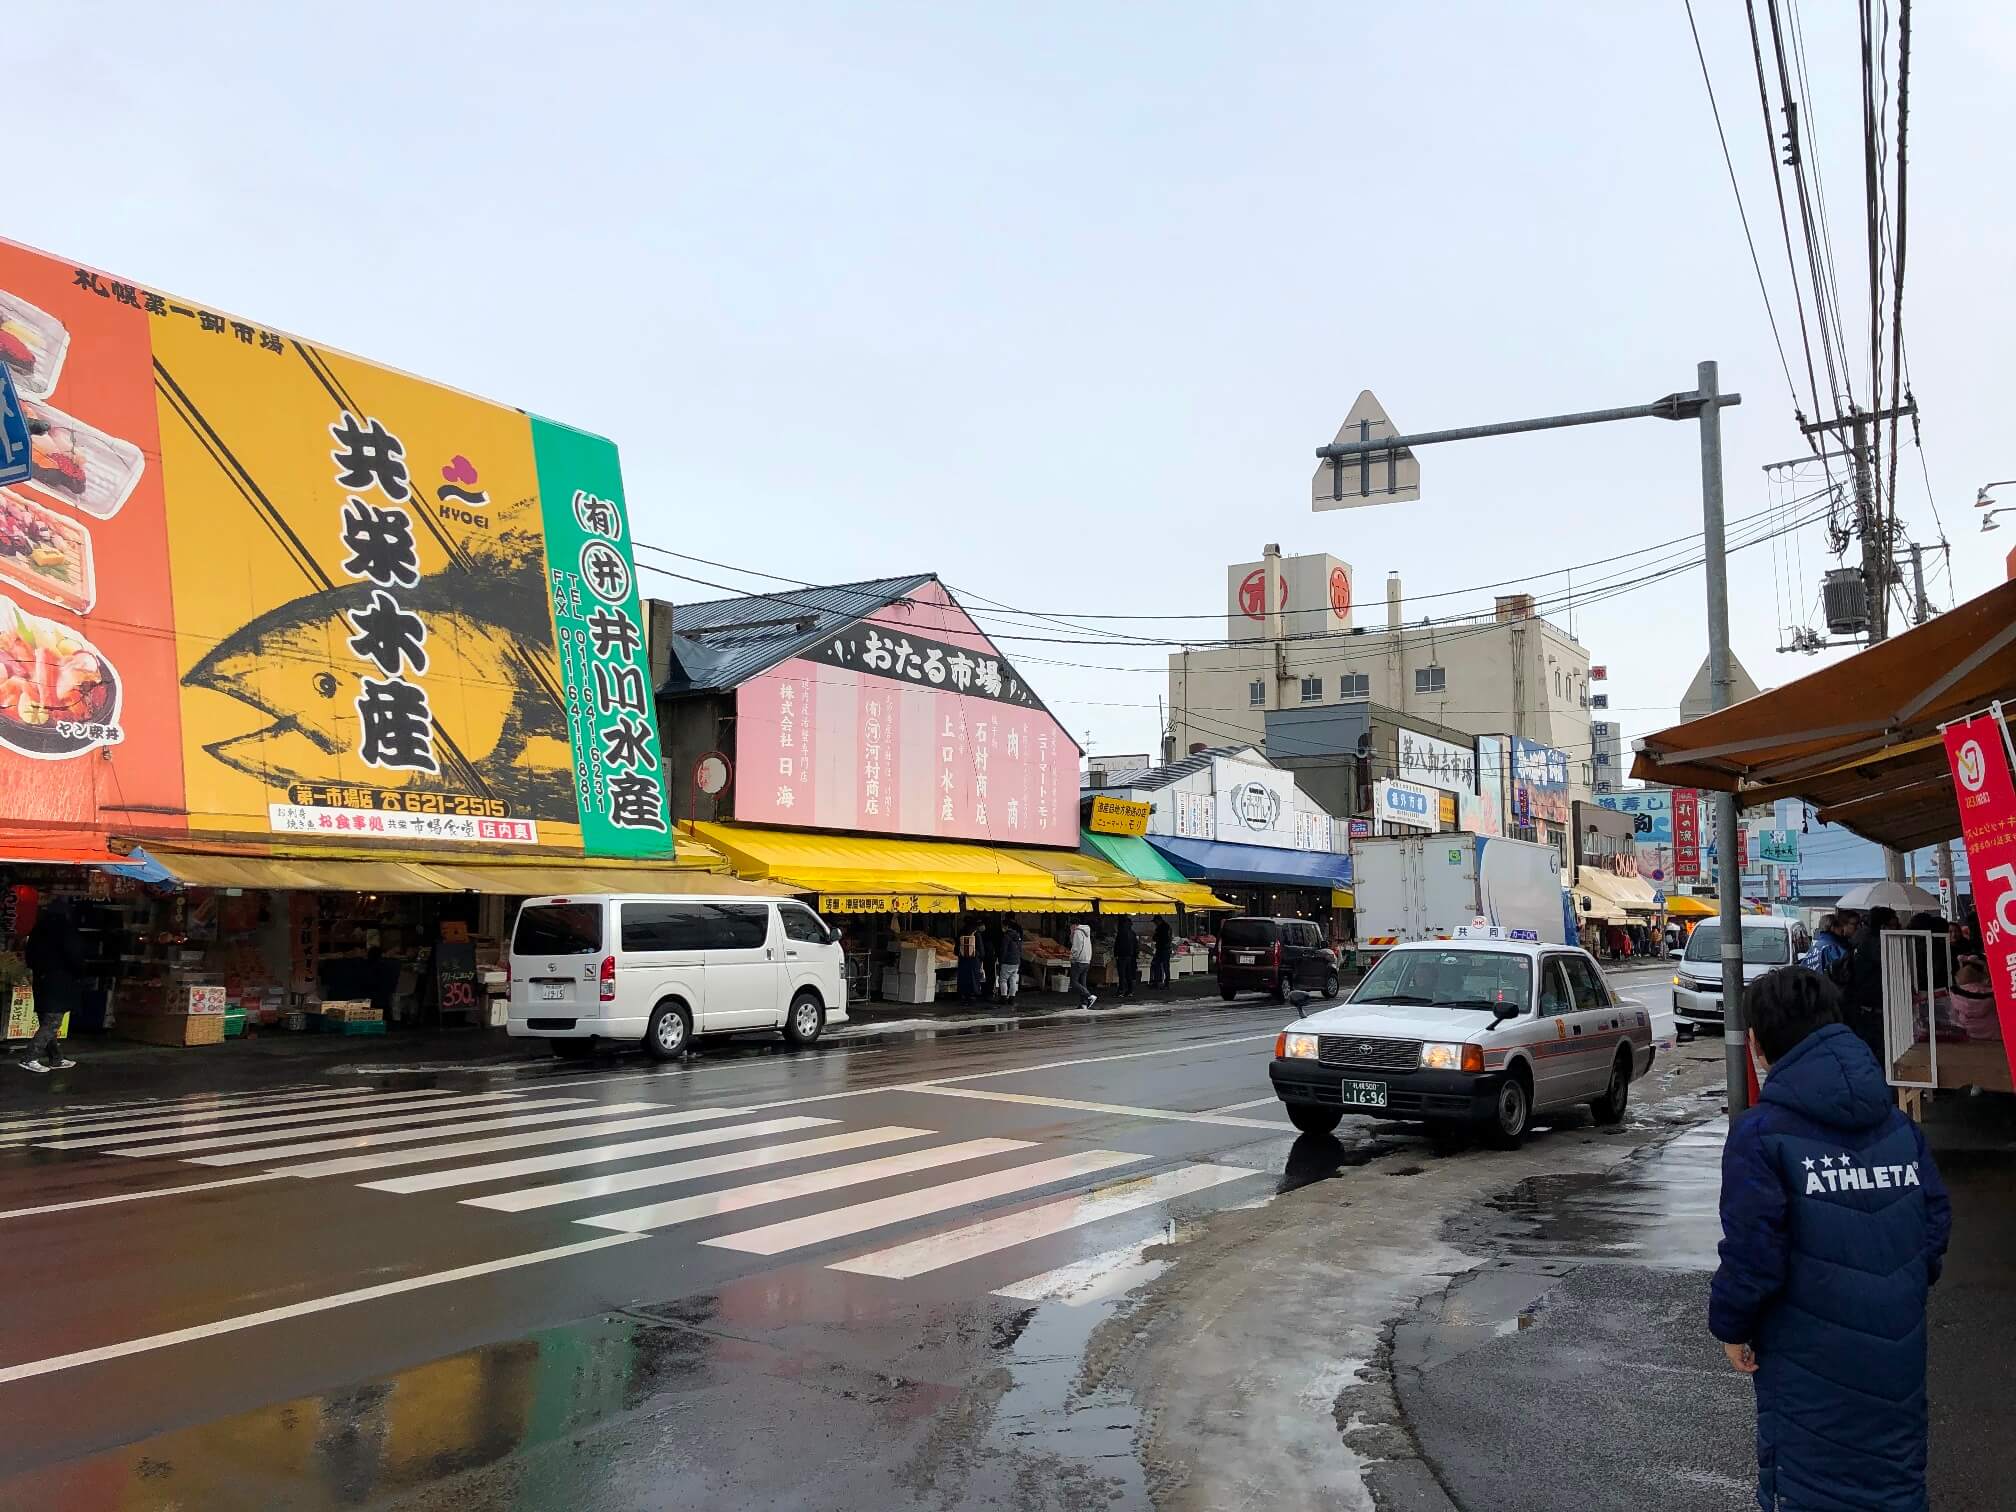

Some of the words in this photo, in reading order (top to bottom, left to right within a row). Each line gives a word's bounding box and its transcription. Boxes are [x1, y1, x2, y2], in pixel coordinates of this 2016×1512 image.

[72, 269, 283, 355] 札幌第一卸市場
[440, 505, 489, 529] KYOEI
[330, 411, 440, 774] 共栄水産
[553, 569, 568, 617] FAX
[568, 574, 583, 620] TEL
[864, 630, 1003, 698] おたる市場
[588, 608, 666, 833] 井川水産
[941, 715, 955, 821] 上口水産
[297, 786, 373, 809] 第一市場店
[405, 795, 506, 817] 621-2515
[319, 814, 384, 832] お食事処
[1354, 1090, 1385, 1105] 16-96
[1805, 1165, 1920, 1194] ATHLETA
